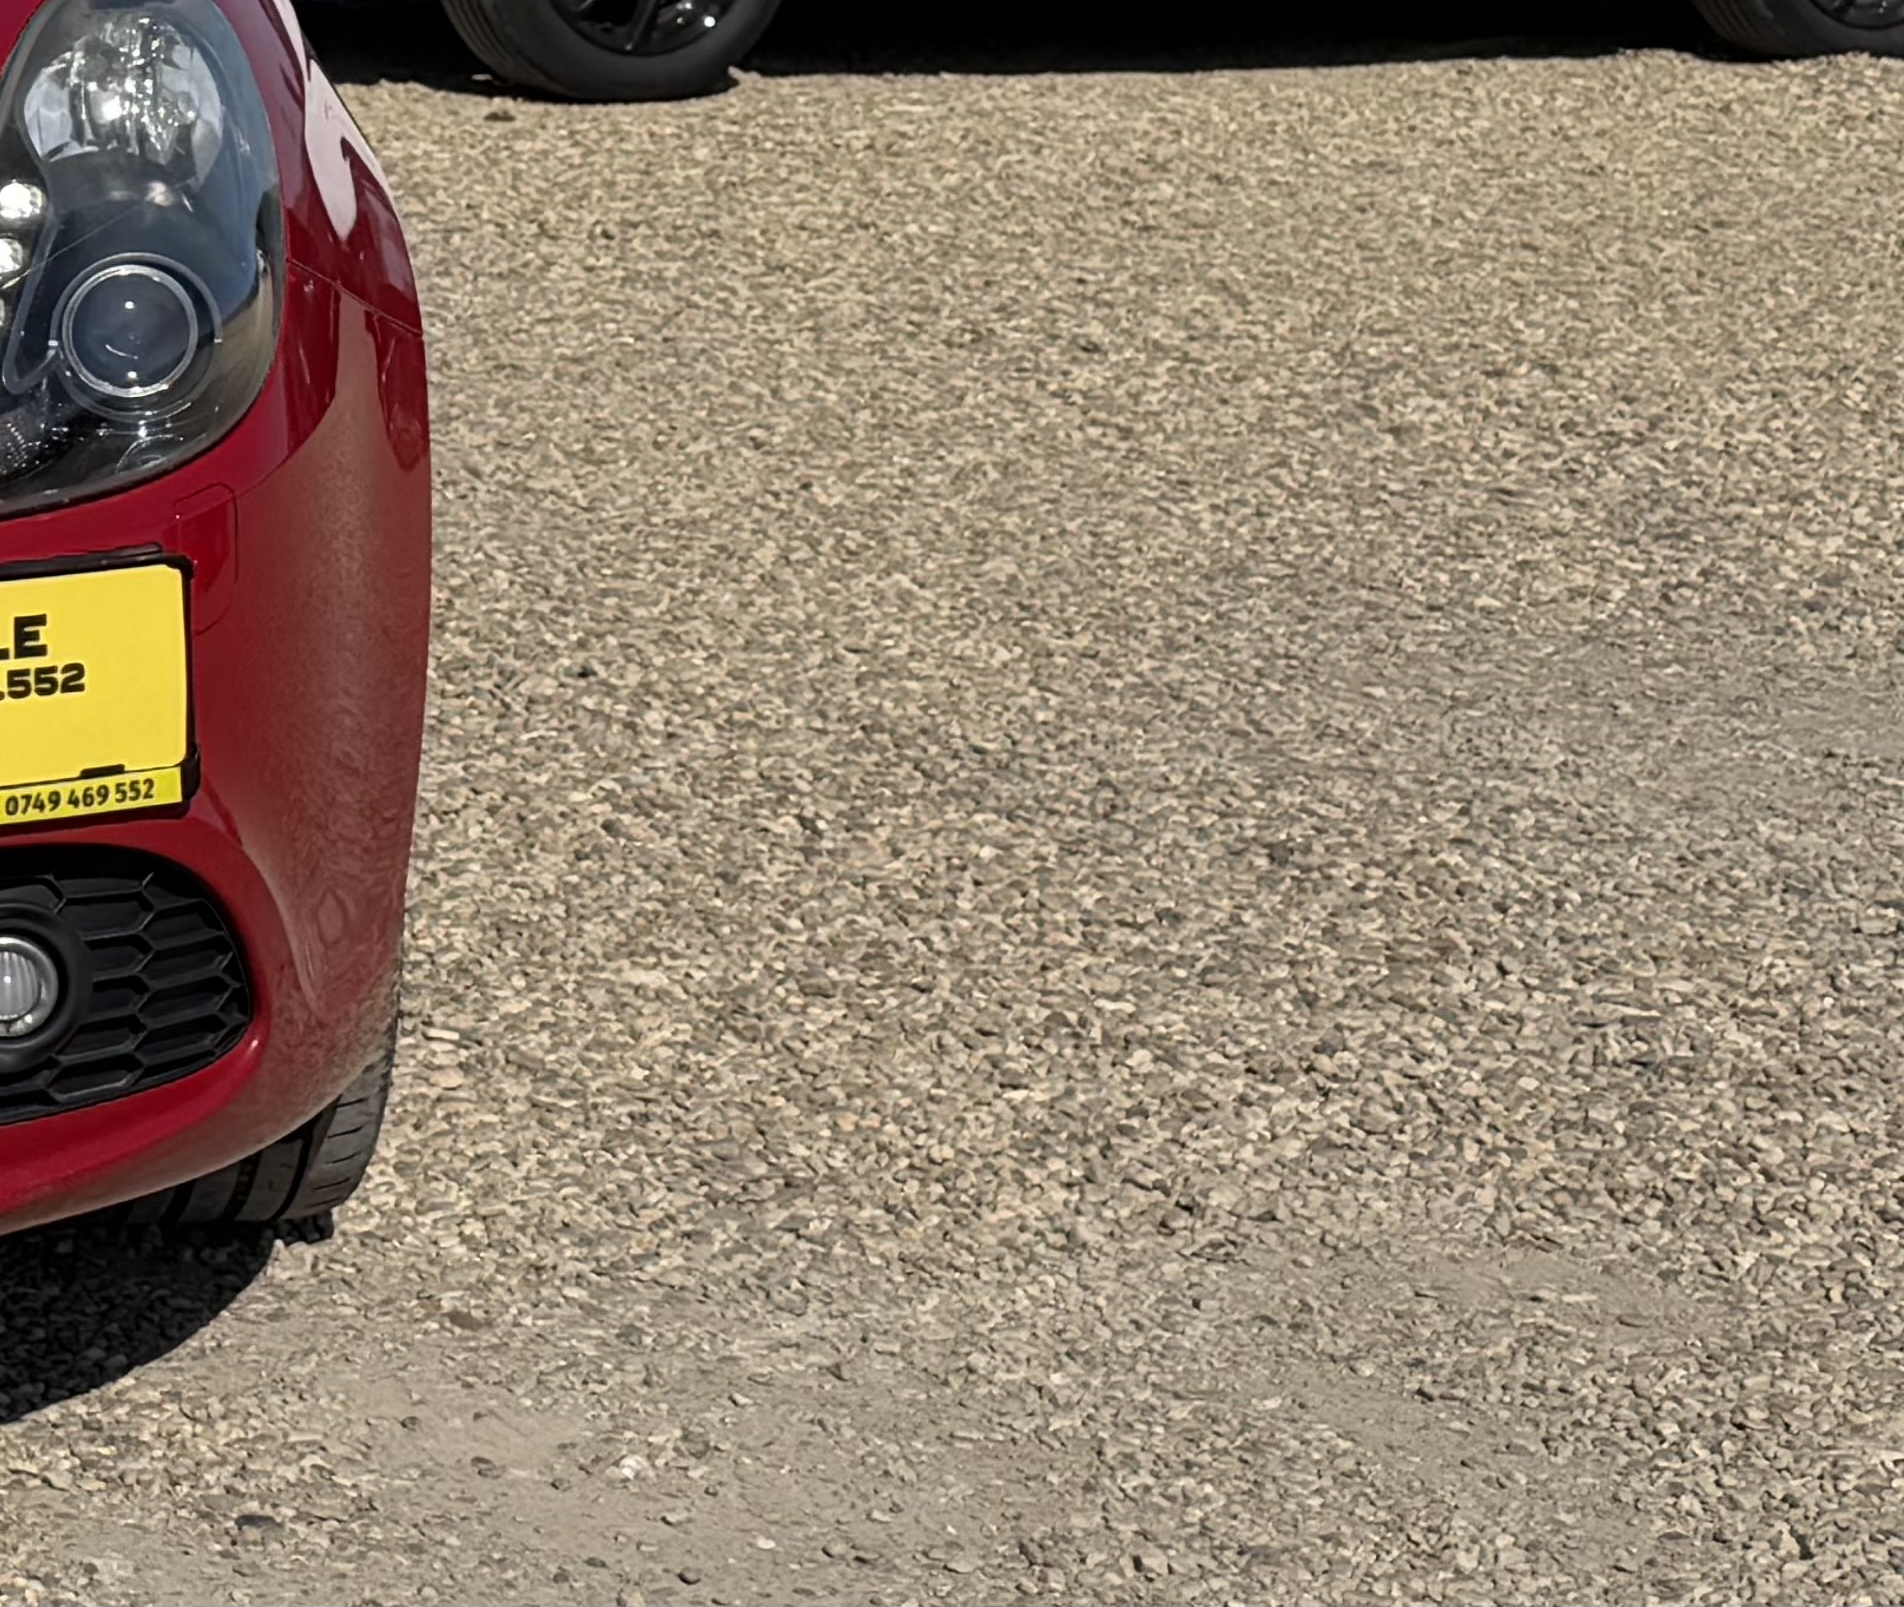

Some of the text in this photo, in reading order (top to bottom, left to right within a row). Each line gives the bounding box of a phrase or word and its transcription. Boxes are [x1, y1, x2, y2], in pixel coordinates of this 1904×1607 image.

[4, 788, 62, 818] 0749
[66, 783, 110, 809] 469
[114, 777, 156, 803] 552
